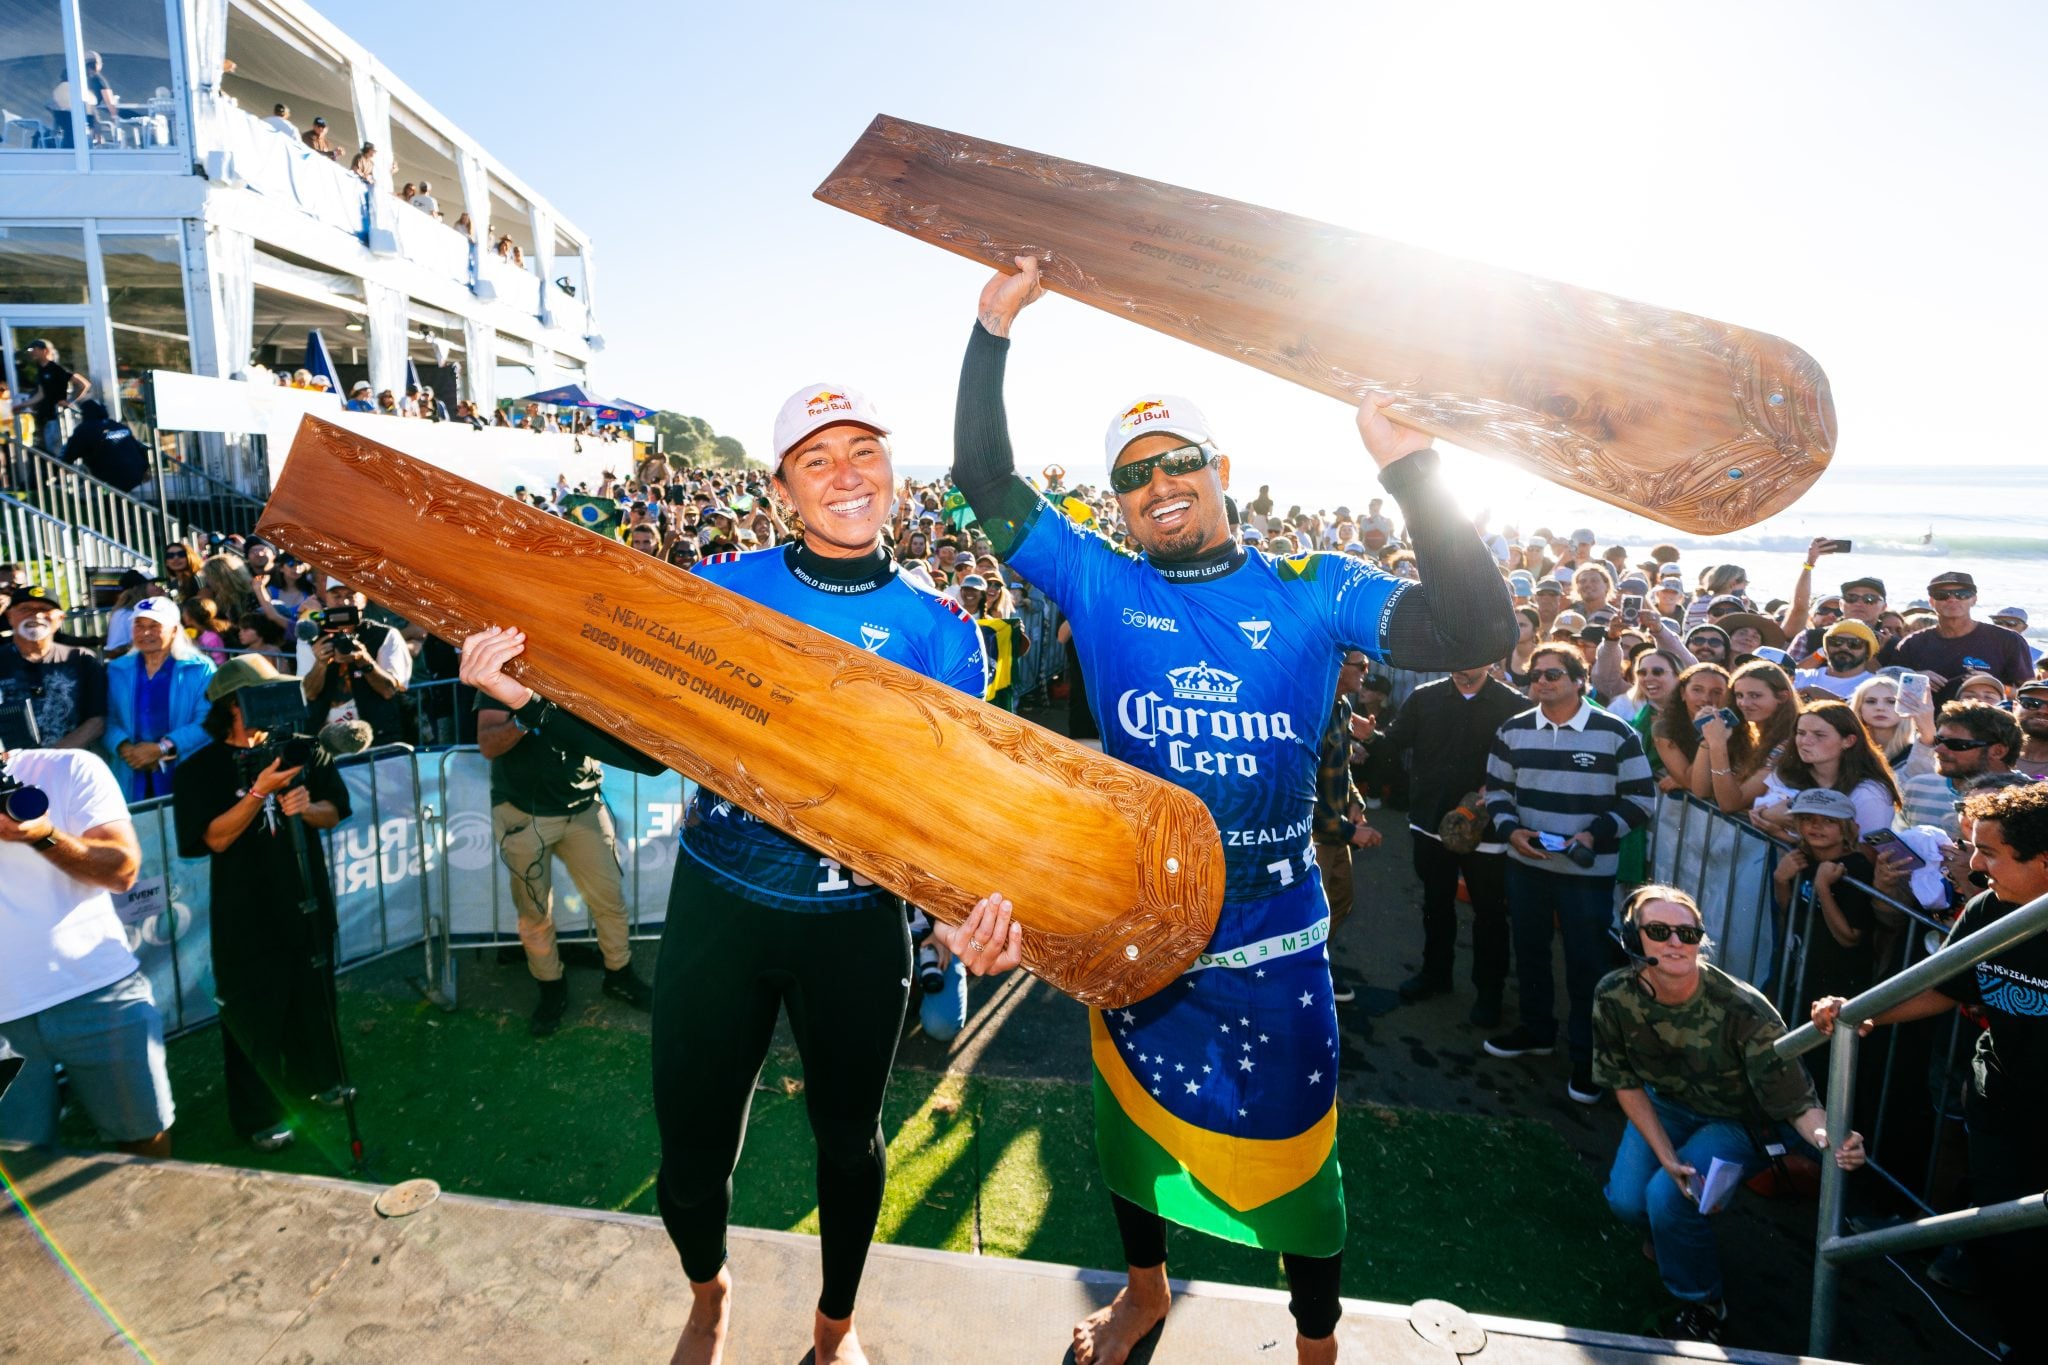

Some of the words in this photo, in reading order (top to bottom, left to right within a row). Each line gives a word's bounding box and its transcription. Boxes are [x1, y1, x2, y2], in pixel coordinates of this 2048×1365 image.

[1152, 223, 1186, 240] NEW
[1185, 232, 1258, 260] ZEALAND
[1130, 241, 1169, 260] 2026
[1216, 266, 1299, 300] CHAMPION
[808, 404, 829, 417] Red
[831, 401, 852, 411] Bull
[1144, 410, 1170, 421] Bull
[794, 566, 819, 587] WORLD
[818, 582, 844, 593] SURF
[844, 580, 877, 593] LEAGUE
[1176, 570, 1200, 578] SURF
[1201, 561, 1230, 576] LEAGUE
[1147, 614, 1179, 633] WSL
[1380, 609, 1391, 636] 2026
[612, 606, 648, 631] NEW
[644, 621, 718, 666] ZEALAND
[715, 659, 763, 688] PRO
[580, 623, 620, 651] 2026
[620, 640, 690, 686] WOMEN'S
[689, 677, 770, 727] CHAMPION
[1118, 689, 1297, 747] Corona
[1168, 739, 1258, 778] Cero
[1227, 814, 1311, 846] ZEALAND
[1993, 964, 2009, 975] NEW
